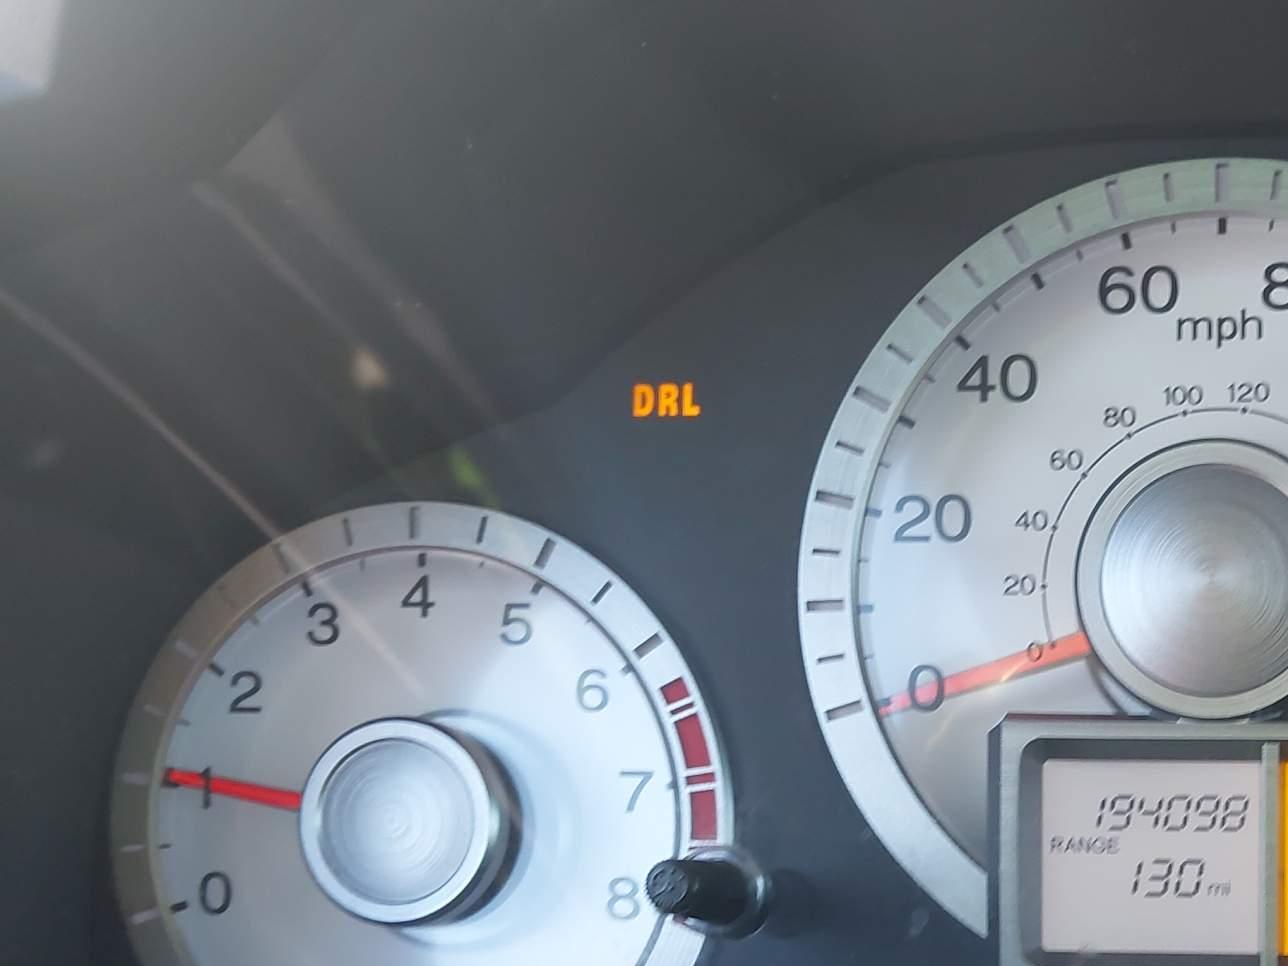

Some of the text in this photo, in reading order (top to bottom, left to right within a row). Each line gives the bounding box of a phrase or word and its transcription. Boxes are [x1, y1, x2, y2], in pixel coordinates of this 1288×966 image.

[1098, 264, 1178, 315] 60
[1177, 311, 1264, 349] mph
[631, 382, 702, 418] DRL
[956, 354, 1038, 404] 40
[1164, 384, 1202, 407] 100
[1228, 382, 1270, 405] 120
[1103, 406, 1137, 429] 80
[1050, 448, 1084, 472] 60
[894, 494, 972, 545] 20
[1014, 509, 1049, 533] 40
[402, 575, 435, 618] 4
[1003, 574, 1036, 597] 20
[308, 603, 341, 647] 3
[500, 603, 532, 647] 5
[1027, 641, 1043, 662] 0
[228, 671, 263, 714] 2
[575, 668, 609, 712] 6
[908, 664, 946, 712] 0
[199, 766, 213, 810] 1
[619, 771, 655, 815] 7
[1094, 794, 1250, 833] 194098
[1049, 836, 1120, 854] RANGE
[200, 871, 233, 915] 0
[607, 876, 642, 921] 8
[1130, 858, 1205, 898] 130
